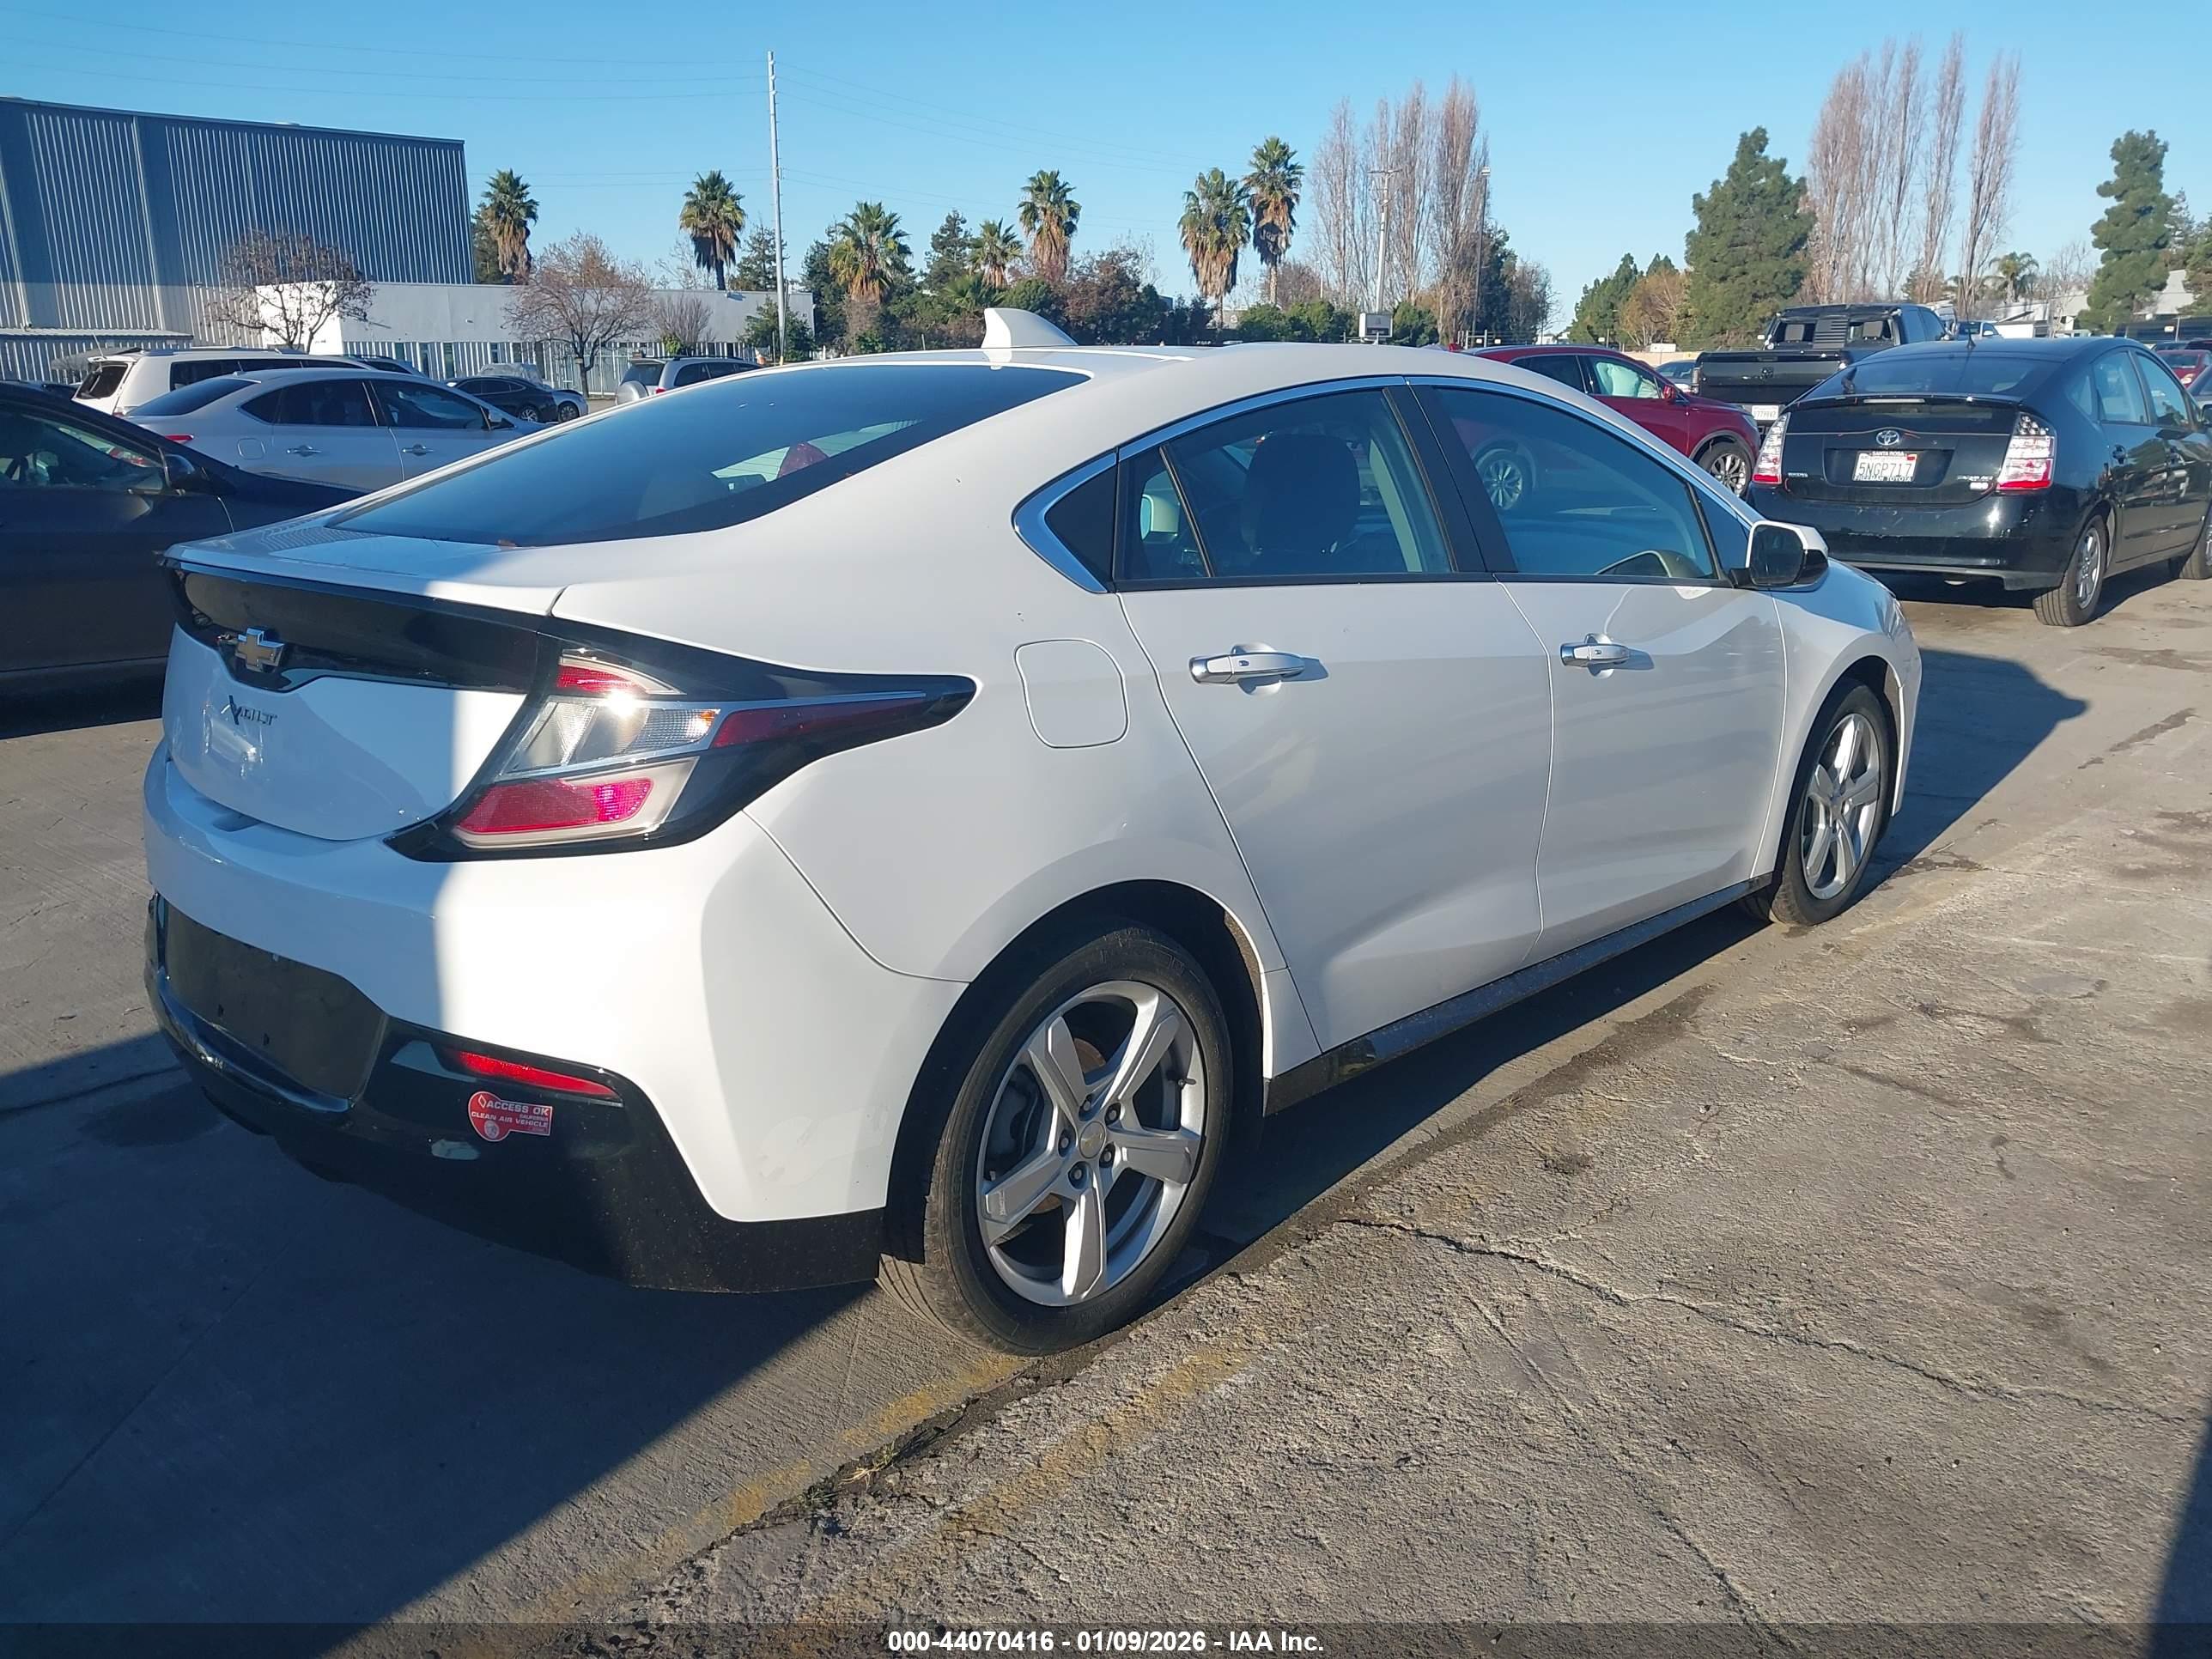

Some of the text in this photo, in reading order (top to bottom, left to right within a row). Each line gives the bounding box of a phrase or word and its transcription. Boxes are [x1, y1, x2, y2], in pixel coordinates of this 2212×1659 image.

[1859, 462, 1912, 477] 5NGP717
[486, 1100, 550, 1116] ACCESS OK
[471, 1111, 496, 1121] CLEAN
[515, 1119, 549, 1127] VEHICLE
